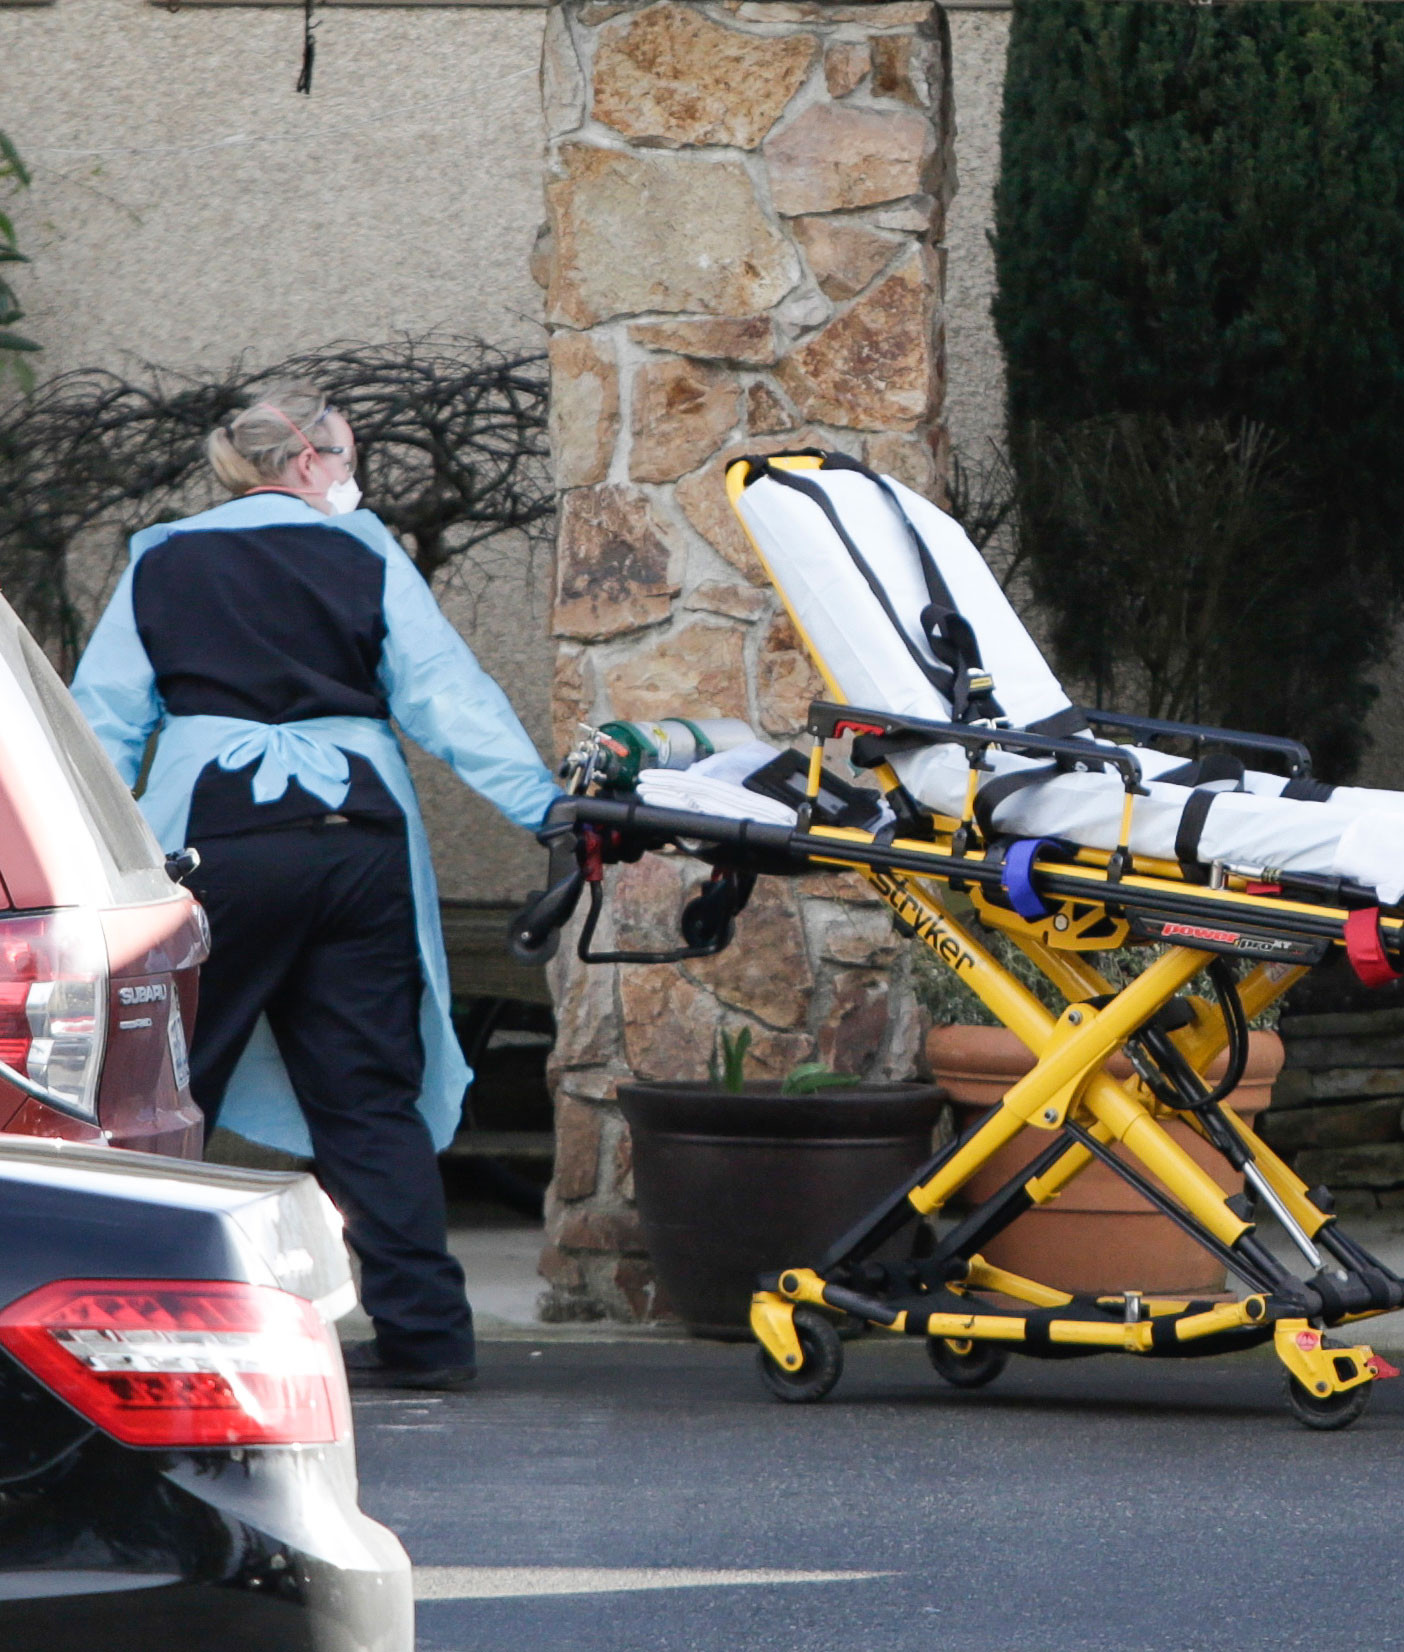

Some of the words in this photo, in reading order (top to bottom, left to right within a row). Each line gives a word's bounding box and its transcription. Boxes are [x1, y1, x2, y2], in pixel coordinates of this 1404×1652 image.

[869, 873, 975, 970] stryker
[1161, 922, 1240, 944] power
[119, 984, 167, 1005] SUBARU
